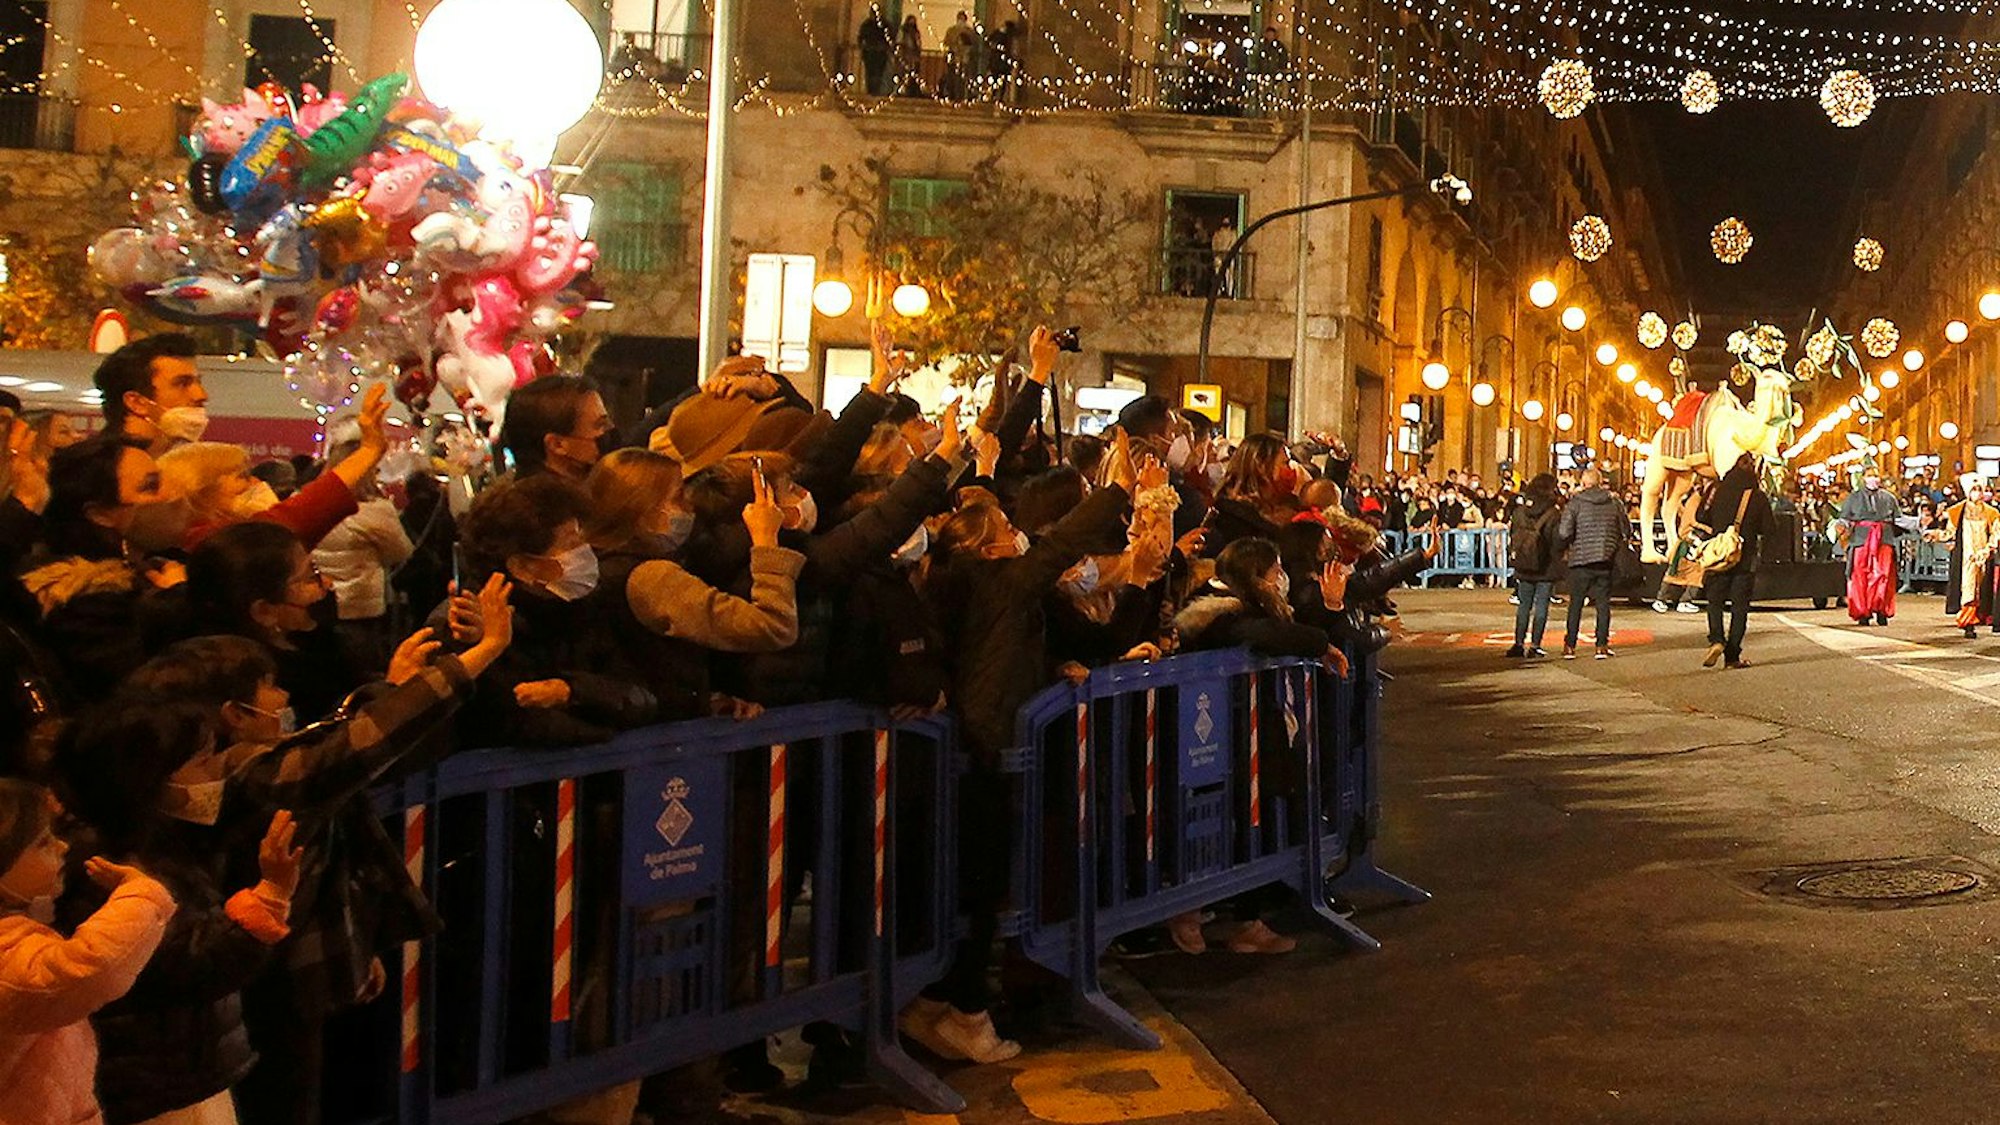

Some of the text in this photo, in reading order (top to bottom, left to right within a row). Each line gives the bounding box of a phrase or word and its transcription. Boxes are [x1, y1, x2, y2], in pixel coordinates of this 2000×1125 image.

[644, 844, 704, 867] Ajuntament
[650, 861, 697, 880] de Palma
